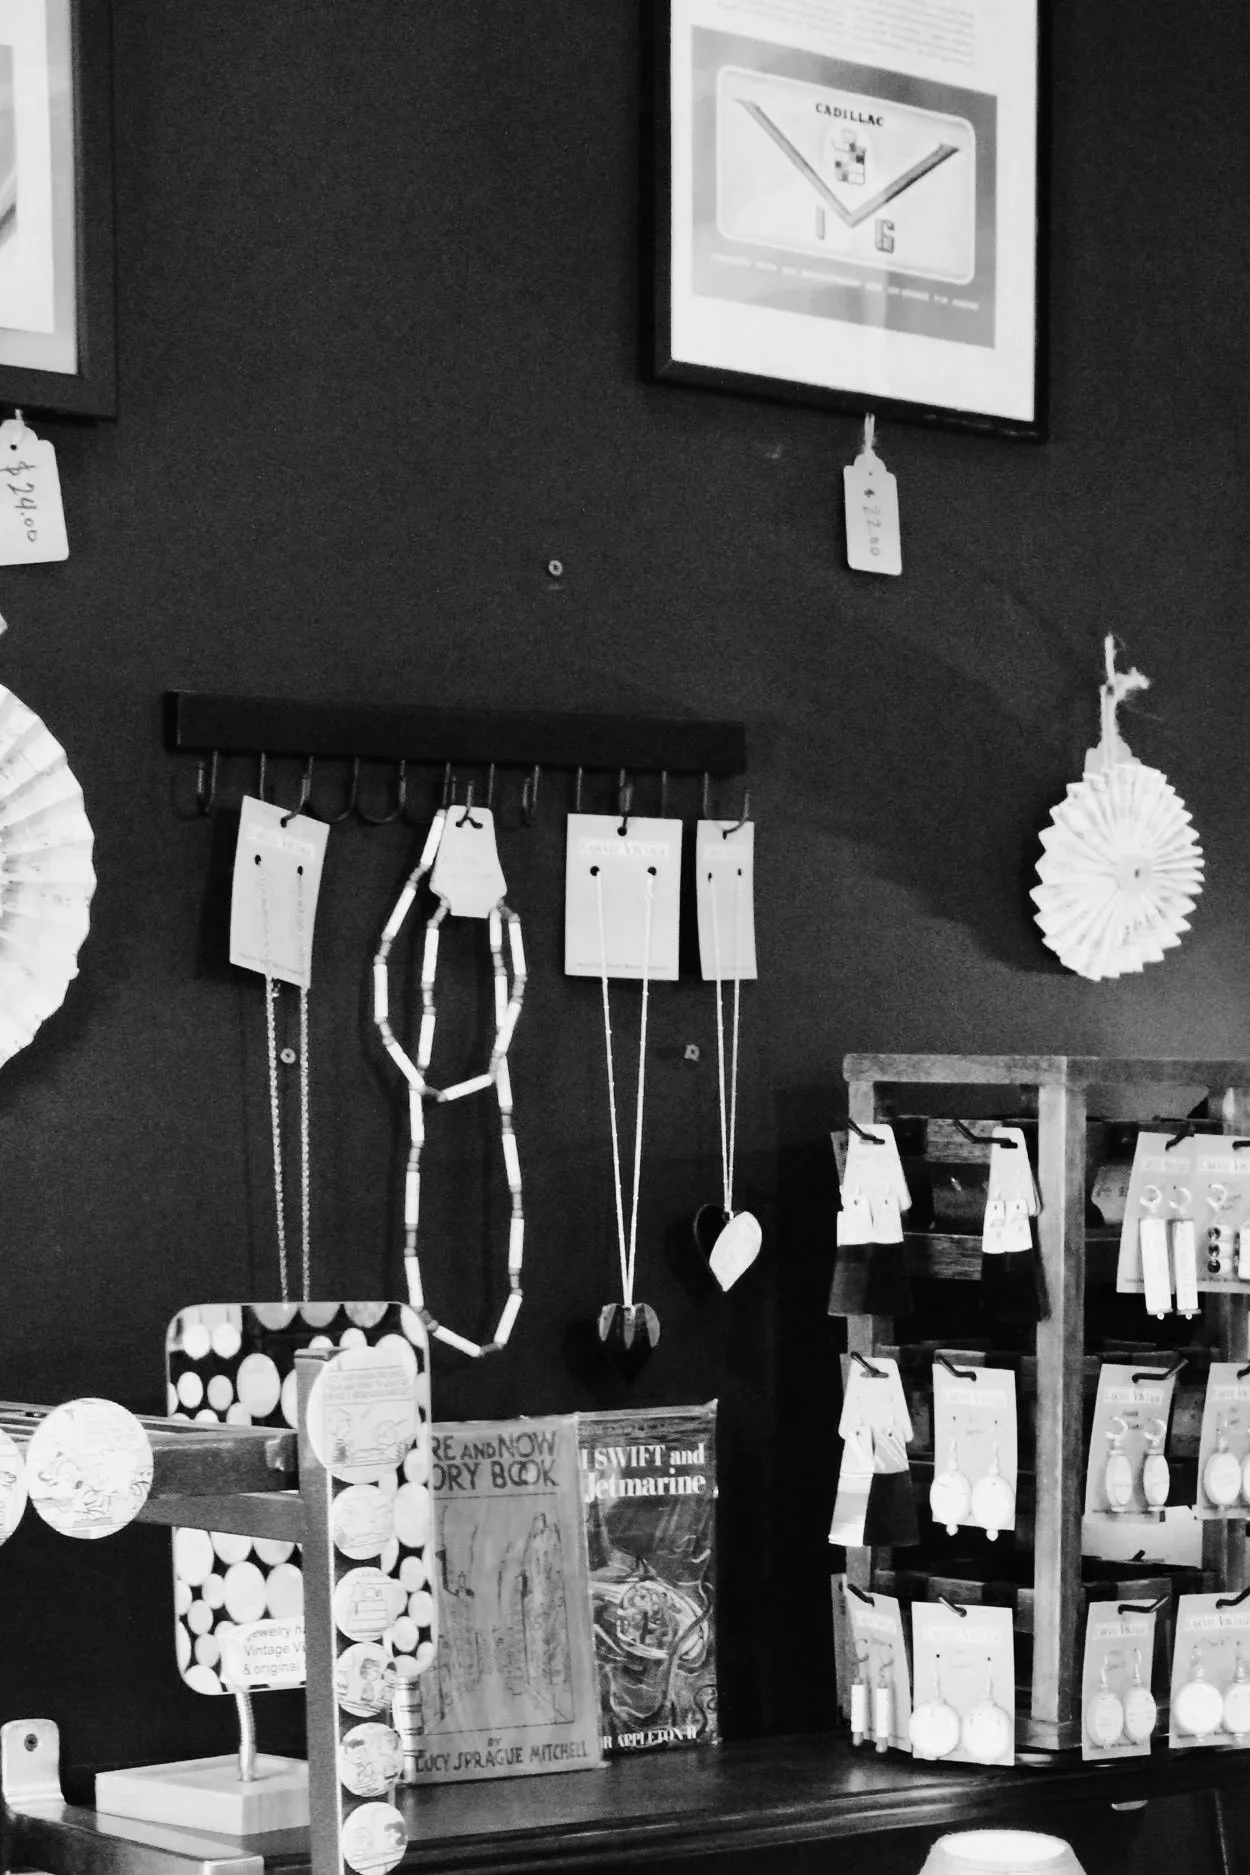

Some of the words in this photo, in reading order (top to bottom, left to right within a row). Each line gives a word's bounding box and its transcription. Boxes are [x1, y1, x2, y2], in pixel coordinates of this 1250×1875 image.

[815, 102, 885, 126] CADILLAC
[431, 1434, 457, 1461] RE
[461, 1441, 497, 1460] AND
[497, 1430, 556, 1458] NOW
[594, 1444, 665, 1470] SWIFT
[669, 1442, 705, 1465] and
[432, 1461, 481, 1491] ORY
[491, 1459, 560, 1489] BOOK
[530, 1740, 588, 1763] MITCHELL
